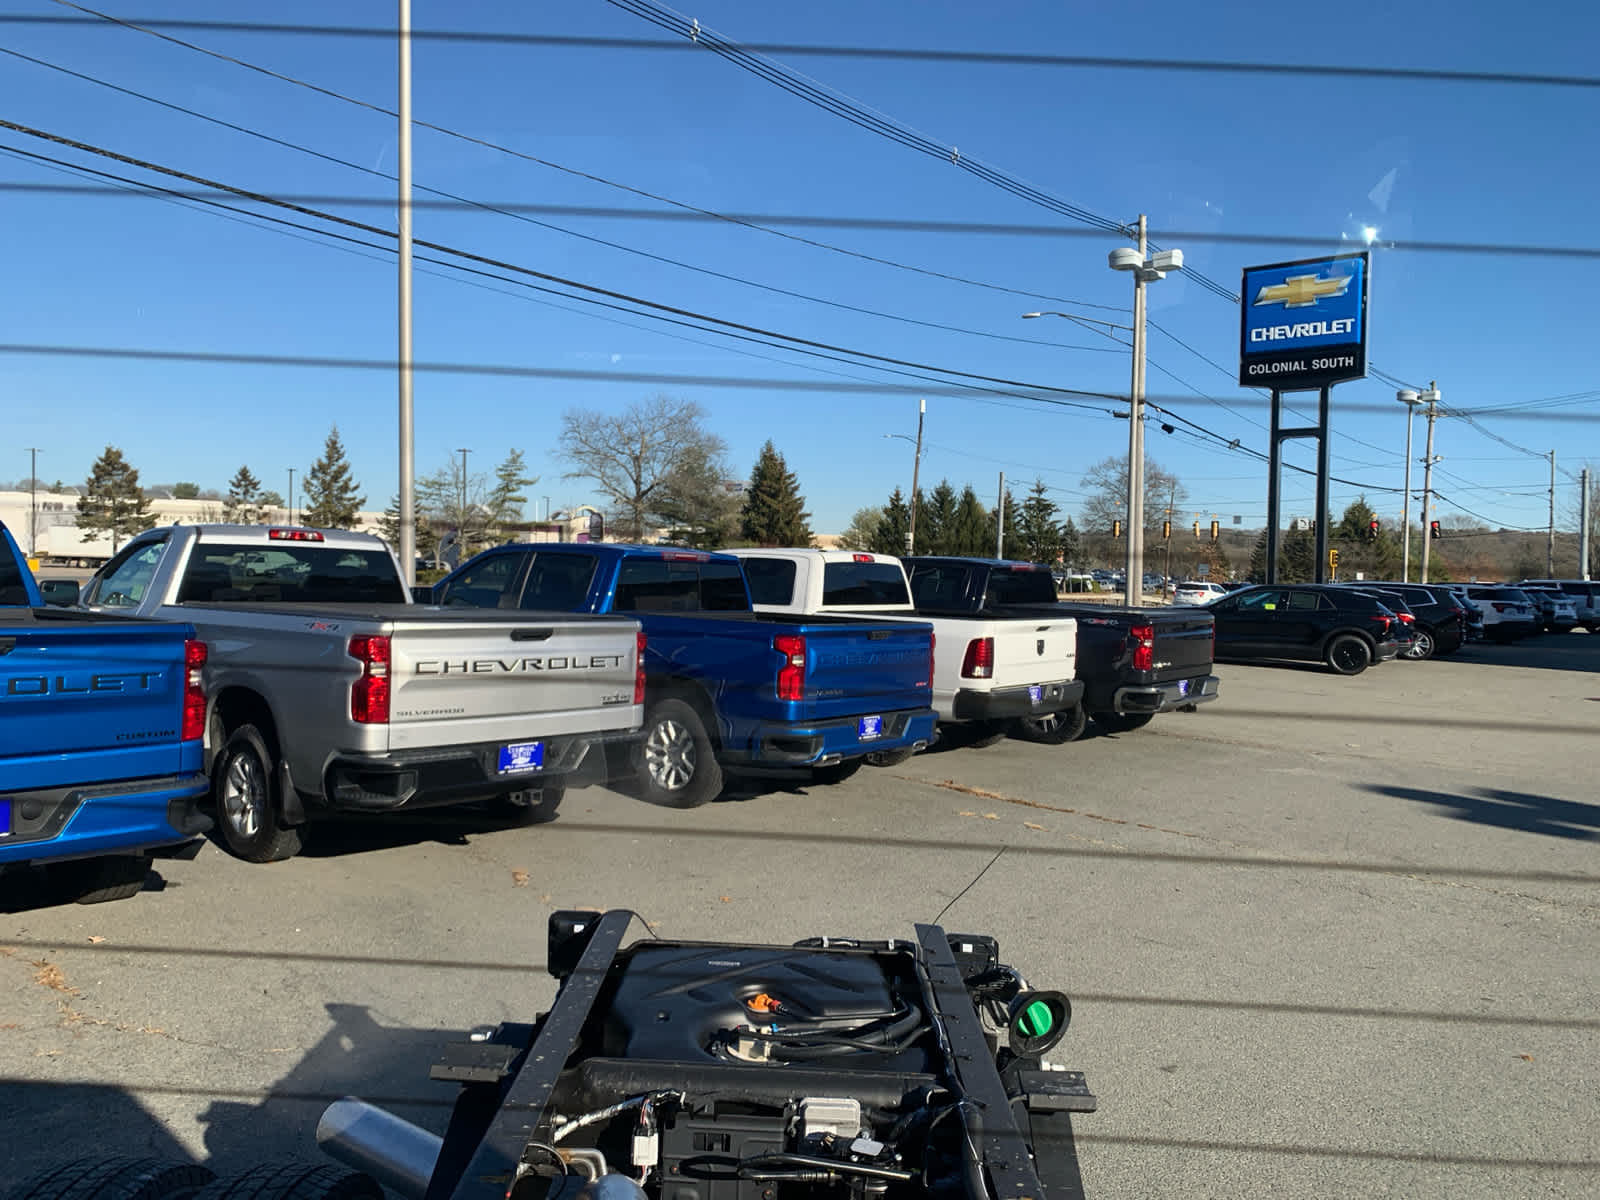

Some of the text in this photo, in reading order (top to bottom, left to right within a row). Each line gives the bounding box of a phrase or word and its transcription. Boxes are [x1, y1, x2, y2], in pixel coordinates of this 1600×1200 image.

[1251, 318, 1355, 342] CHEVROLET
[1248, 356, 1355, 375] COLONIAL SOUTH
[415, 654, 625, 675] CHEVROLET
